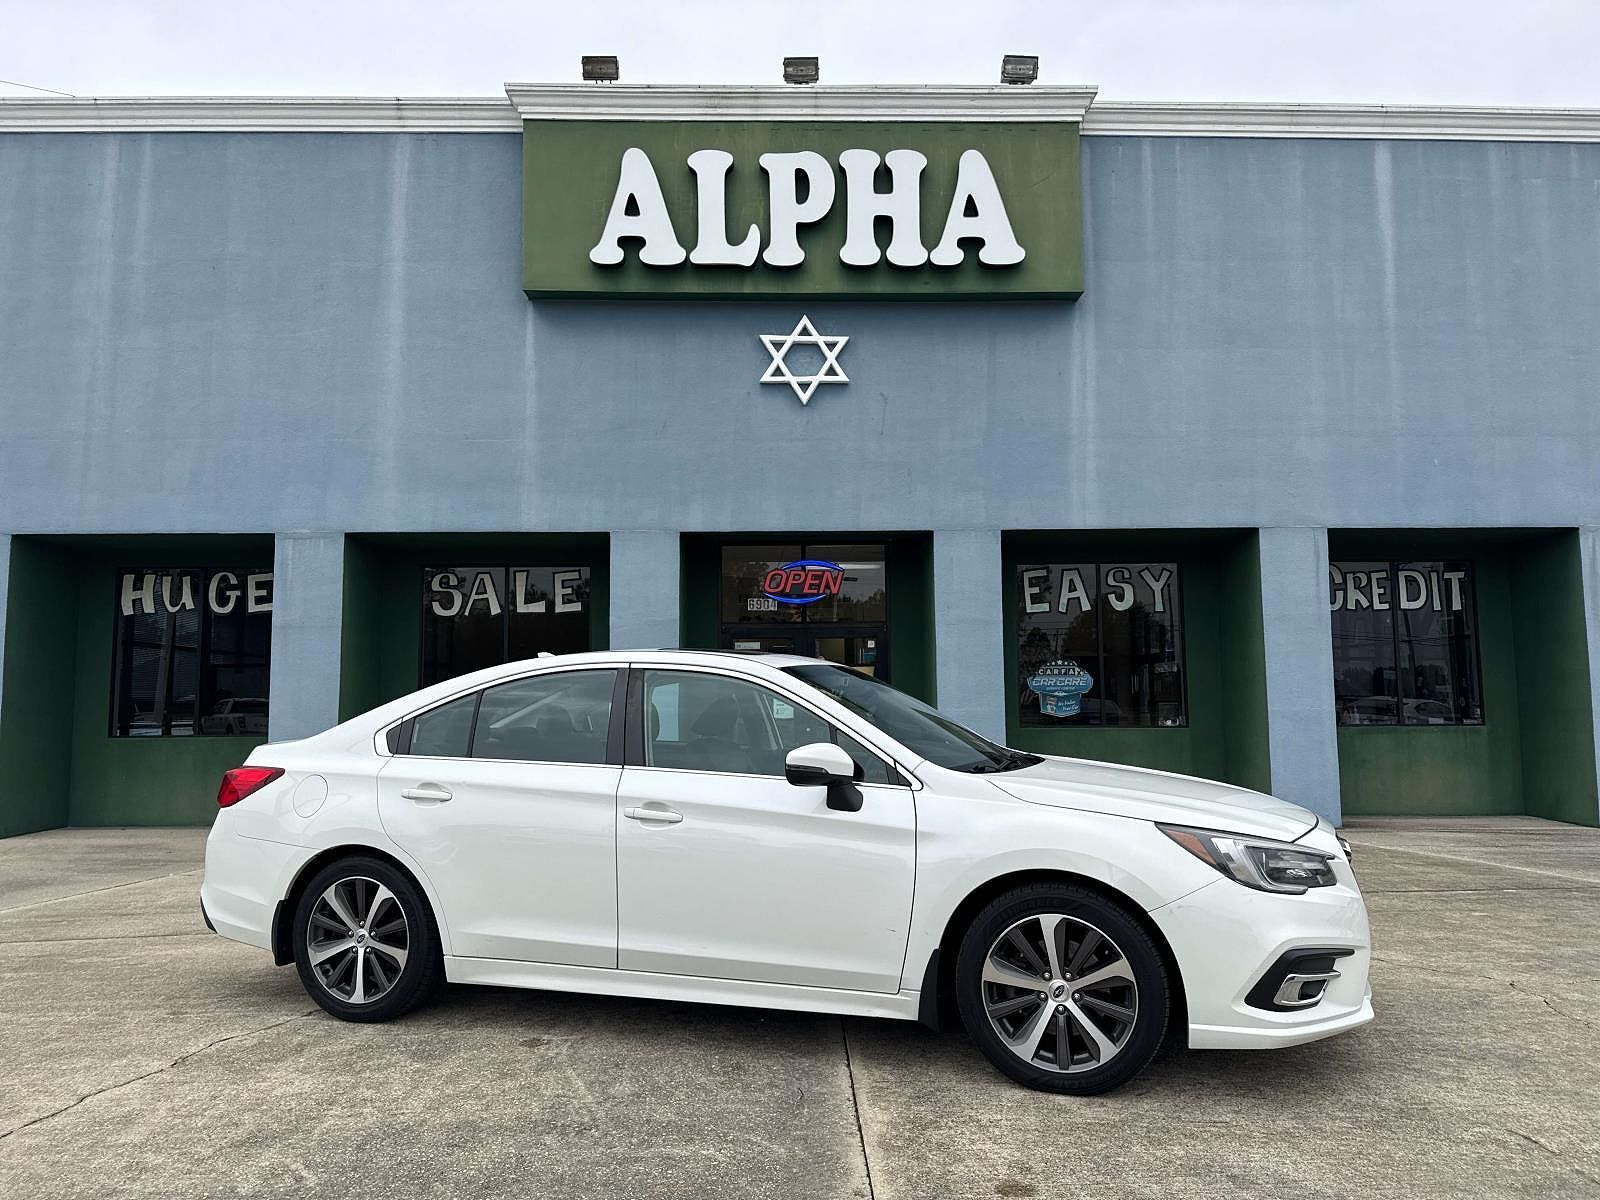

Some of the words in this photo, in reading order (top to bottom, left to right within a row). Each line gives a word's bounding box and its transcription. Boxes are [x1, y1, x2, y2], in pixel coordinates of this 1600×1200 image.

[589, 147, 1027, 268] ALPHA
[120, 571, 274, 616] HUGE
[430, 569, 584, 617] SALE
[764, 569, 844, 594] OPEN
[1022, 567, 1173, 614] EASY
[748, 599, 777, 610] 6904
[1032, 678, 1055, 686] CAR
[1057, 678, 1087, 686] CARE
